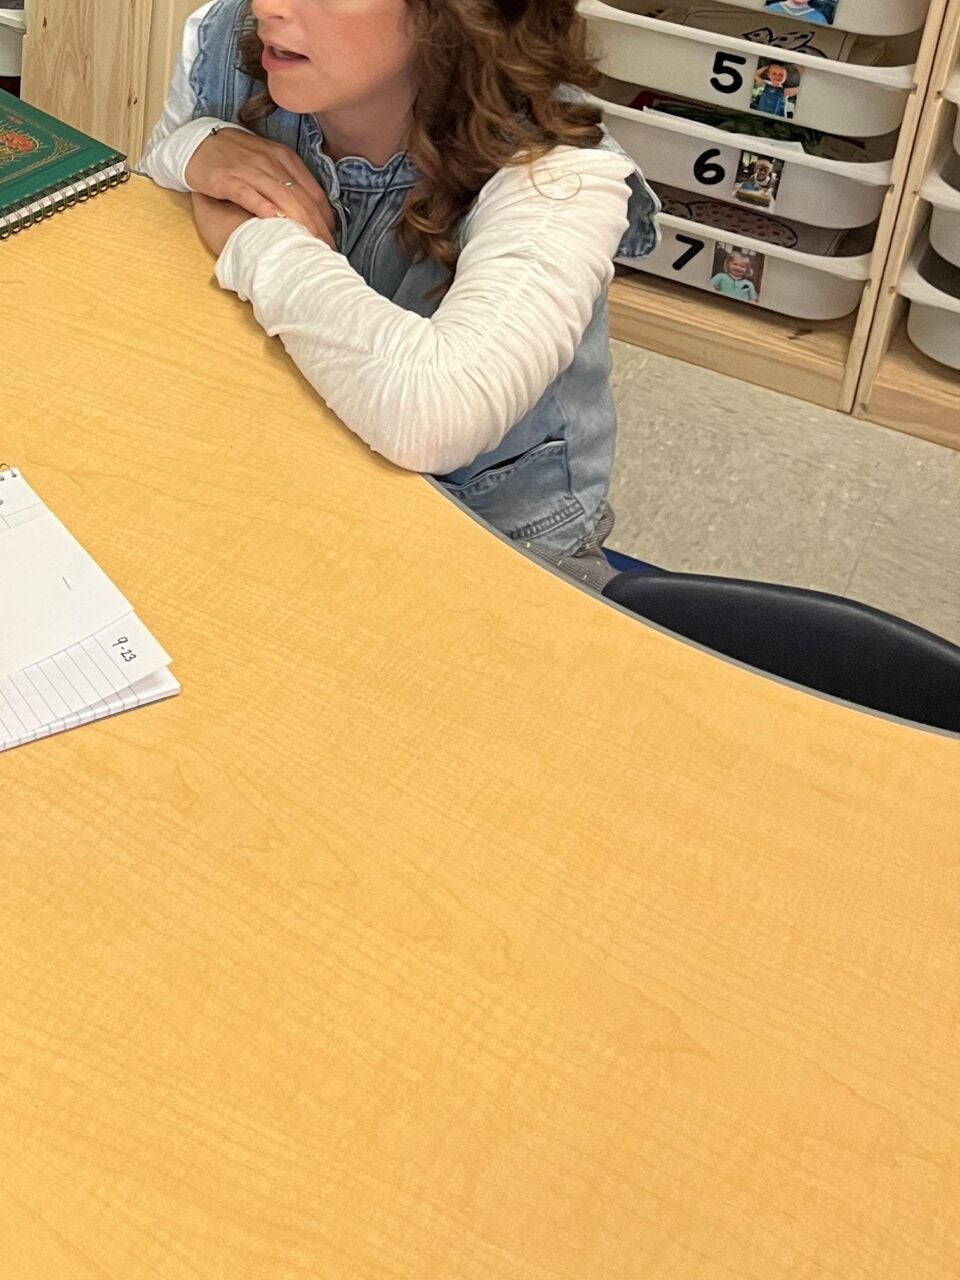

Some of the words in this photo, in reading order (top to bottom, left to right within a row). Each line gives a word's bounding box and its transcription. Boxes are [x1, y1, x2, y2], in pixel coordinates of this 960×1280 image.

[709, 51, 746, 94] 5
[693, 148, 725, 185] 6
[672, 234, 705, 270] 7
[112, 636, 137, 662] 9-23
